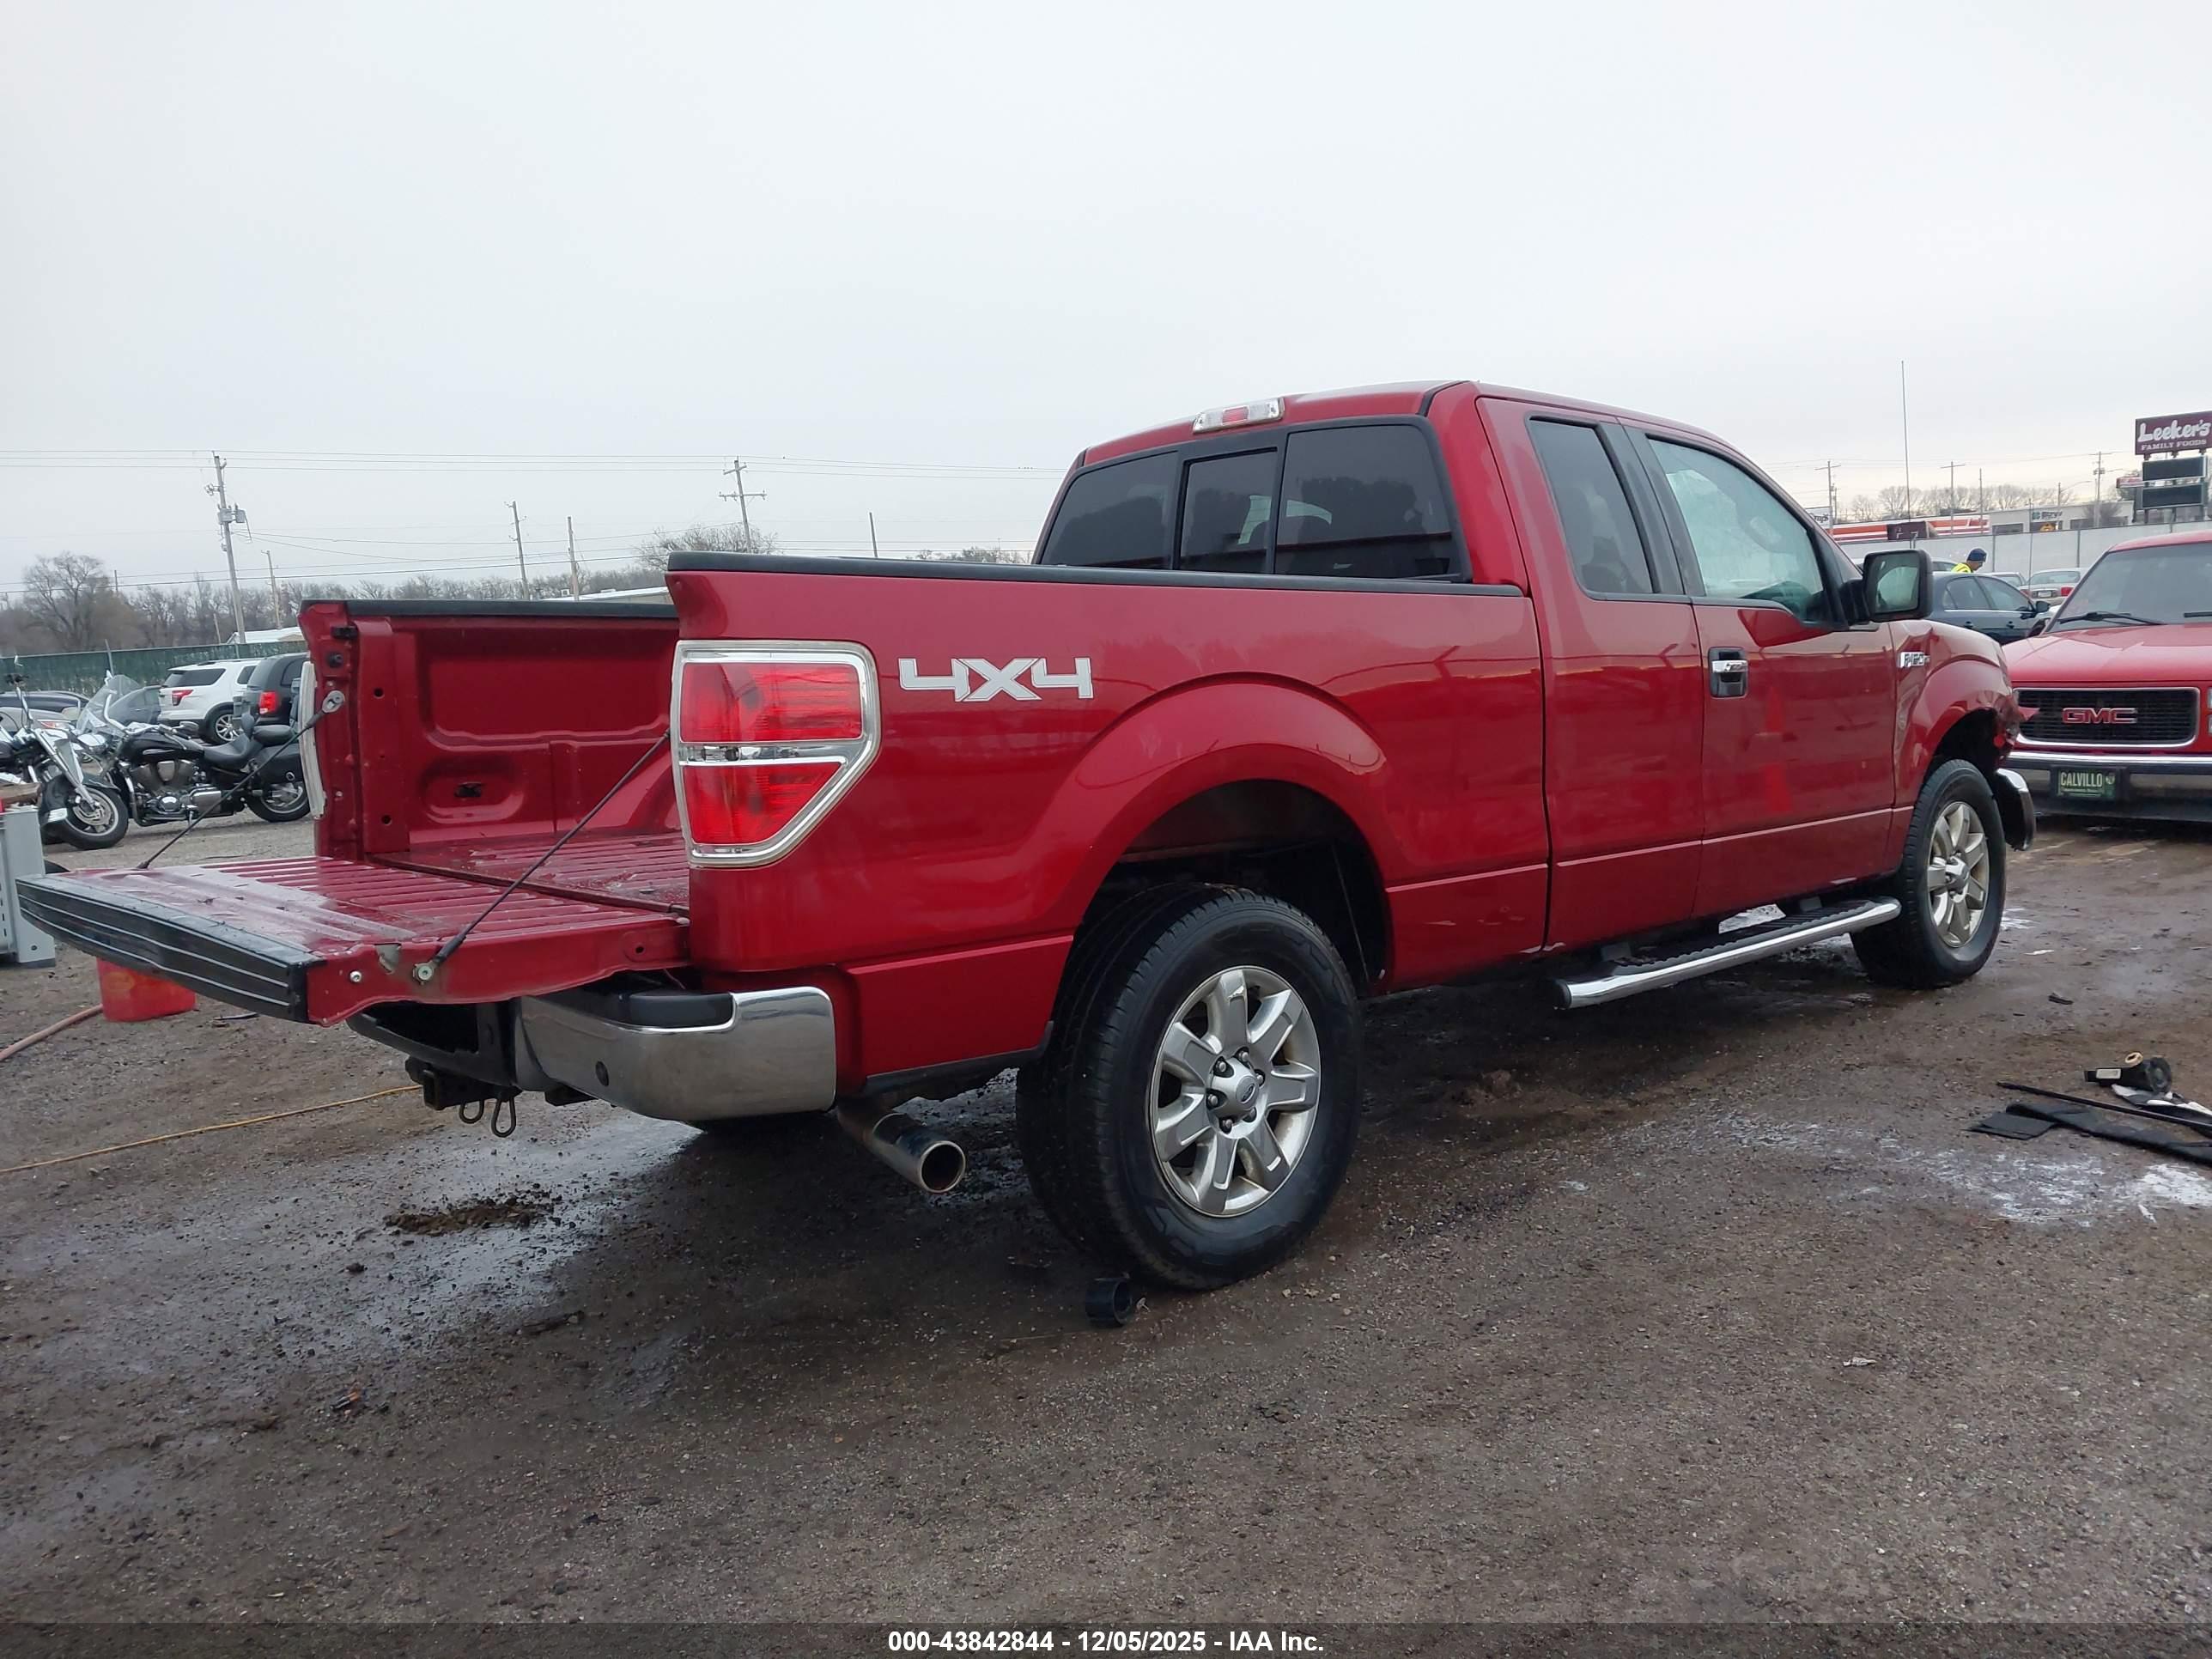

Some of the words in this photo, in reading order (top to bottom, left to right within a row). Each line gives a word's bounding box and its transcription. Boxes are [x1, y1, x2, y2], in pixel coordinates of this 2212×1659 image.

[2137, 419, 2212, 442] Leeker's
[2142, 442, 2175, 451] FAMILY
[2176, 439, 2207, 447] FOODS
[2063, 708, 2137, 724] GMC
[2061, 772, 2103, 787] CALVILLO
